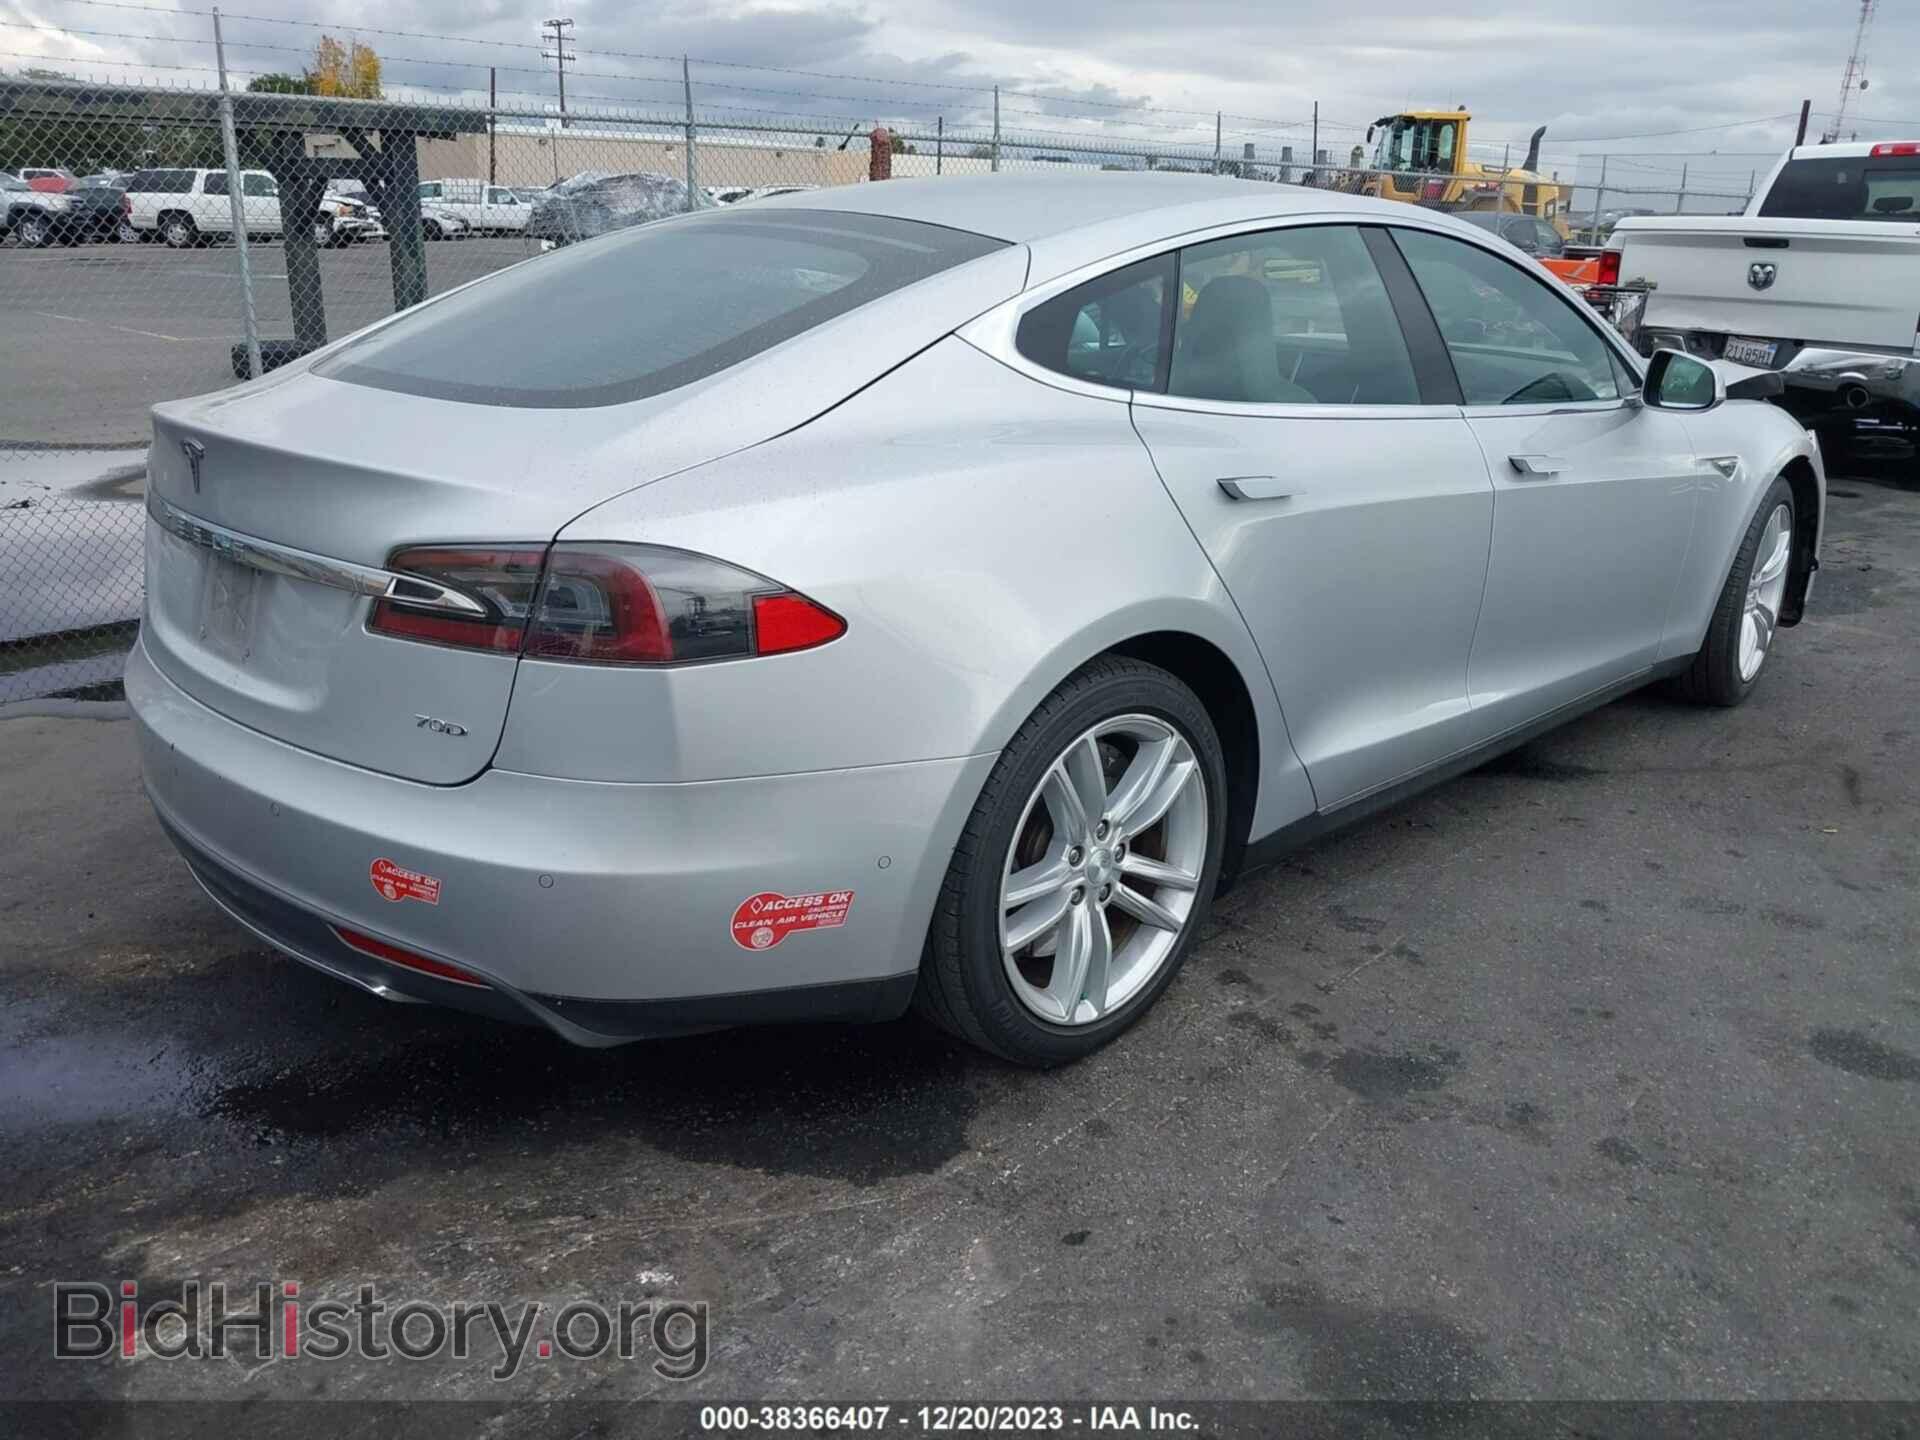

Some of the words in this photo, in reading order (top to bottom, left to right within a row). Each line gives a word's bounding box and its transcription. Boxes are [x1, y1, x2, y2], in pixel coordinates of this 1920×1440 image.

[415, 713, 469, 736] 70D
[385, 866, 421, 882] ACCESS
[424, 877, 438, 886] OK
[762, 895, 824, 911] ACCESS
[828, 892, 850, 904] OK
[734, 918, 773, 929] CLEAN
[777, 916, 797, 925] AIR
[801, 910, 846, 922] VEHICLE
